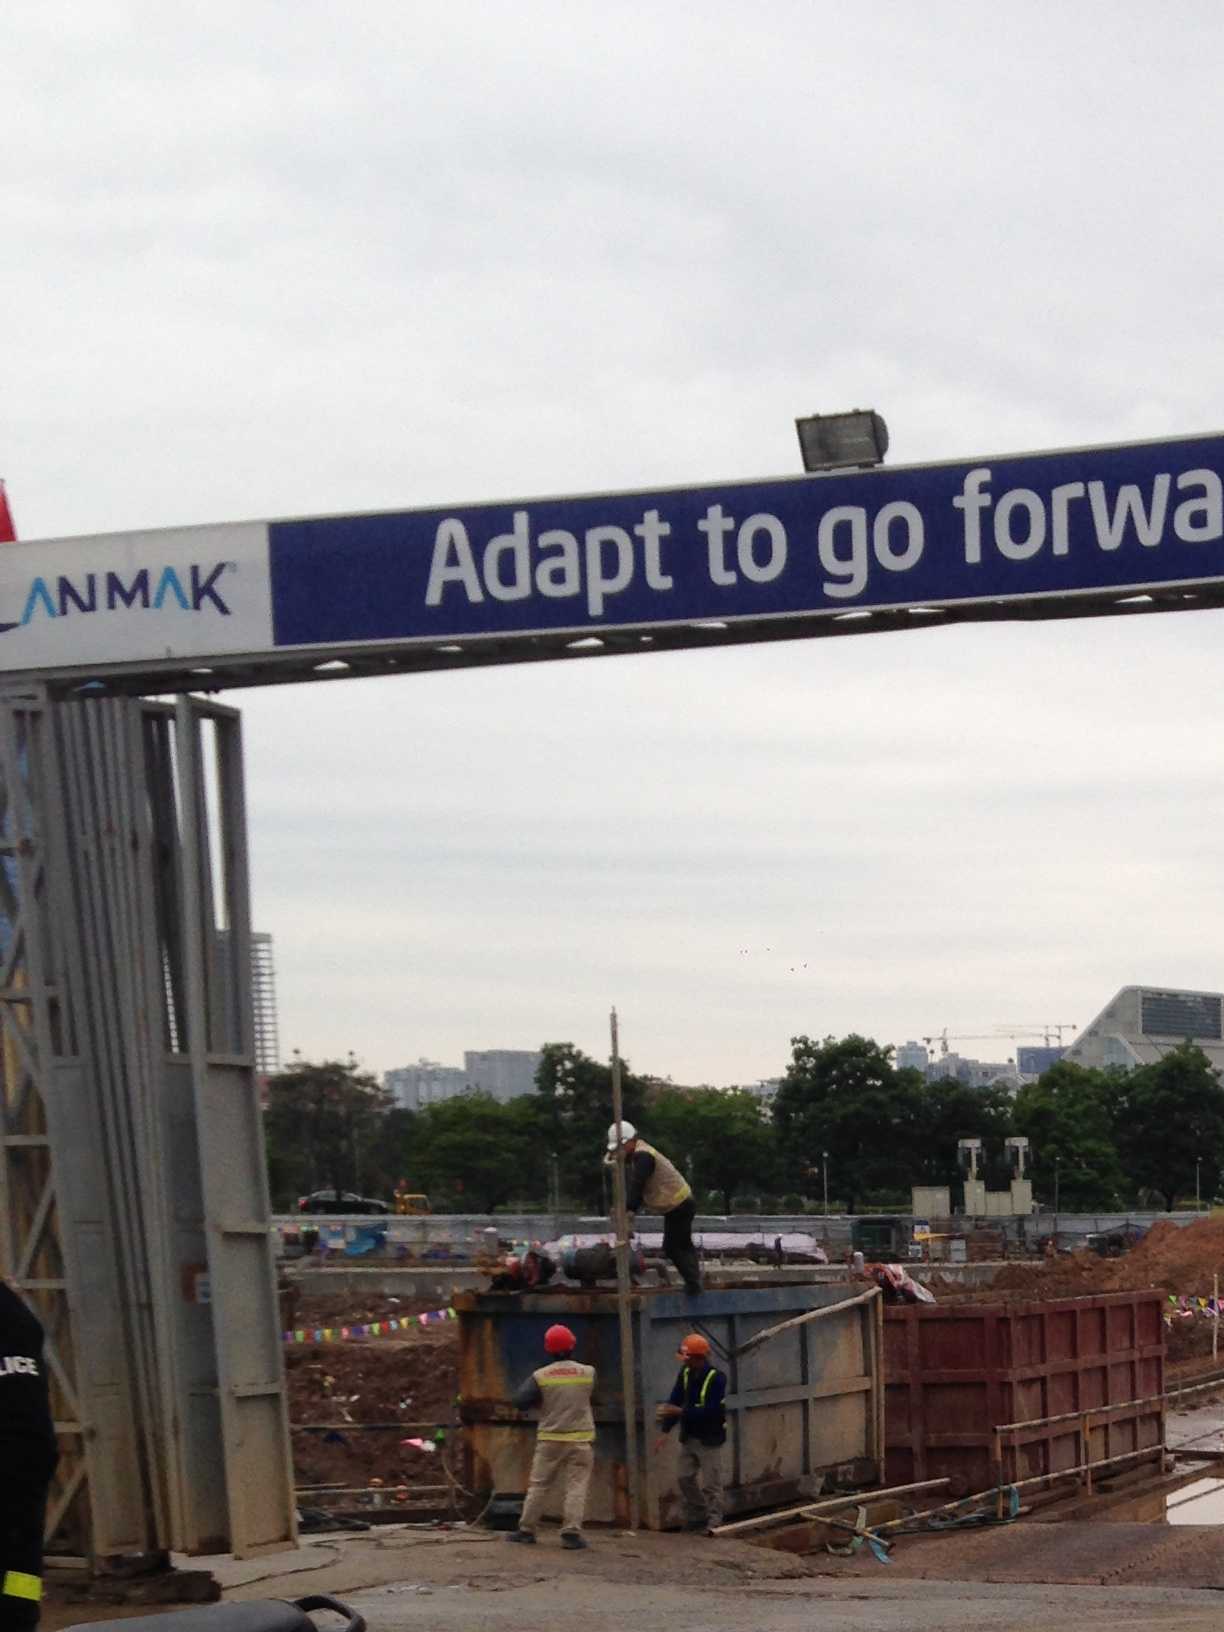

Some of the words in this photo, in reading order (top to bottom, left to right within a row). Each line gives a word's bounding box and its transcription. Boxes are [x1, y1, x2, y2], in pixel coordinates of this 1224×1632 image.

[0, 561, 232, 633] ANMAK
[424, 509, 674, 617] Adapt
[697, 503, 789, 587] to
[816, 500, 925, 598] go
